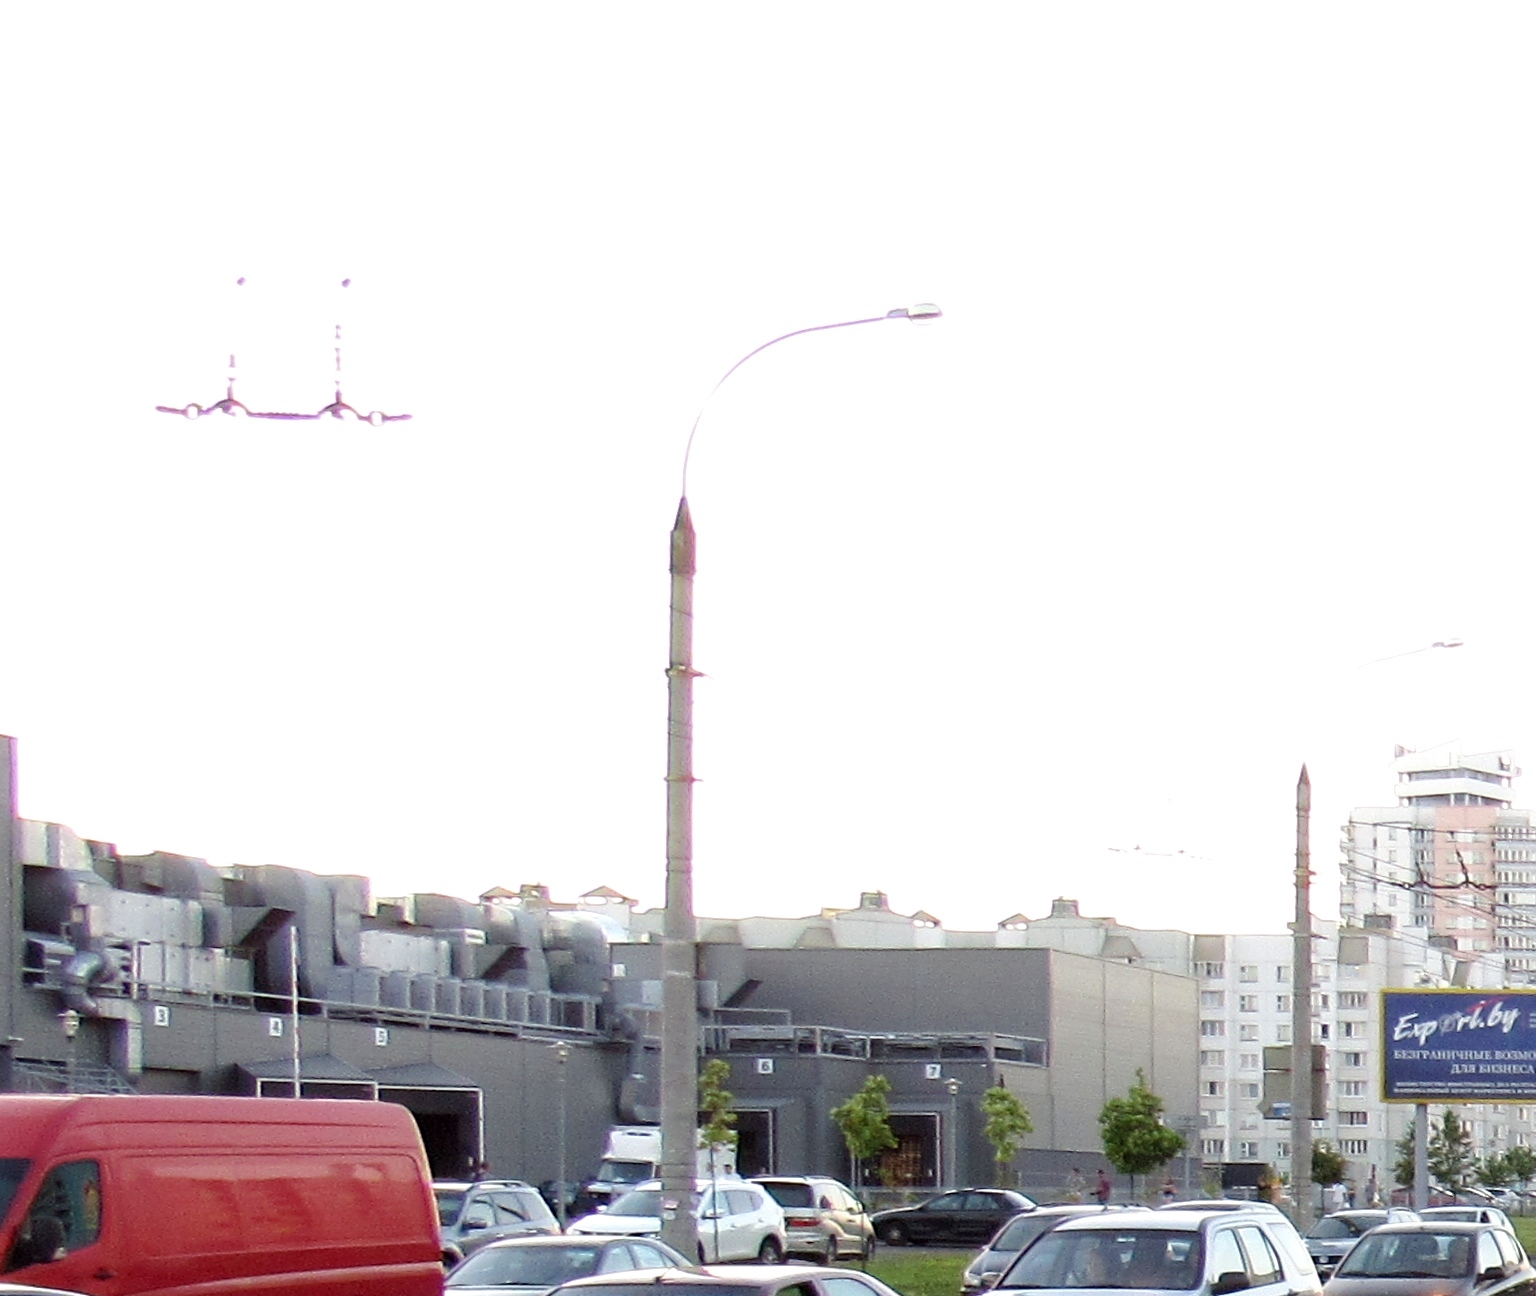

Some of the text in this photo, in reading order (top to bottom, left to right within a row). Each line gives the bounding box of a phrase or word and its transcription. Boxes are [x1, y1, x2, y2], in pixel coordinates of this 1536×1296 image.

[1394, 1050, 1492, 1061] БЕЗГРАНИЧНЫЕ
[1450, 1063, 1536, 1075] ДЛЯ БИЗНЕСА
